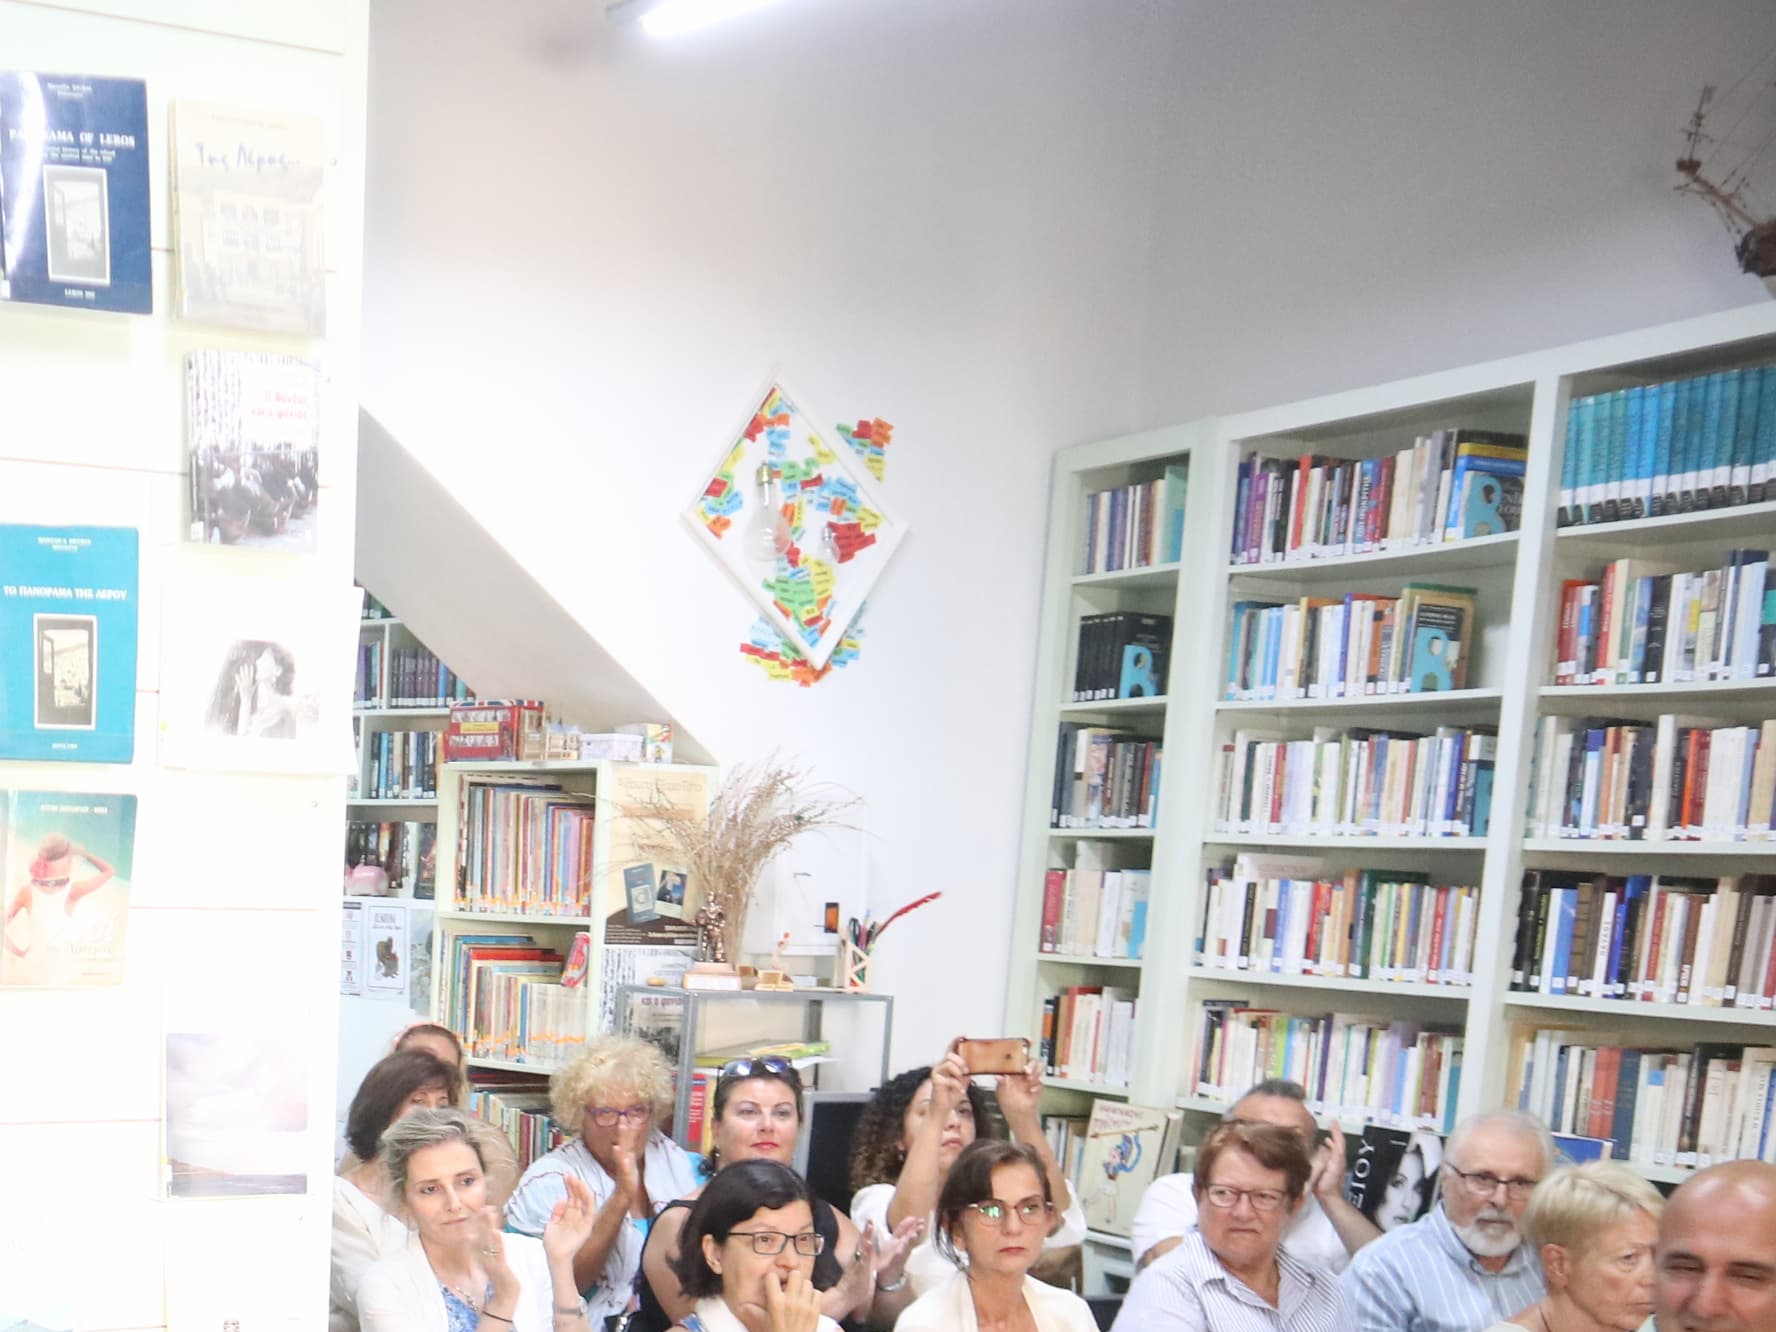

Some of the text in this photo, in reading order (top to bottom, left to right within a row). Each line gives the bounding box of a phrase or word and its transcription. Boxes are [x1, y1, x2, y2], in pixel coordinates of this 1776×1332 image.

[18, 586, 73, 598] ΠΑΝΟΡΑΜΑ
[74, 588, 93, 600] ΤΗΣ
[95, 589, 128, 601] ΛΕΡΟΥ
